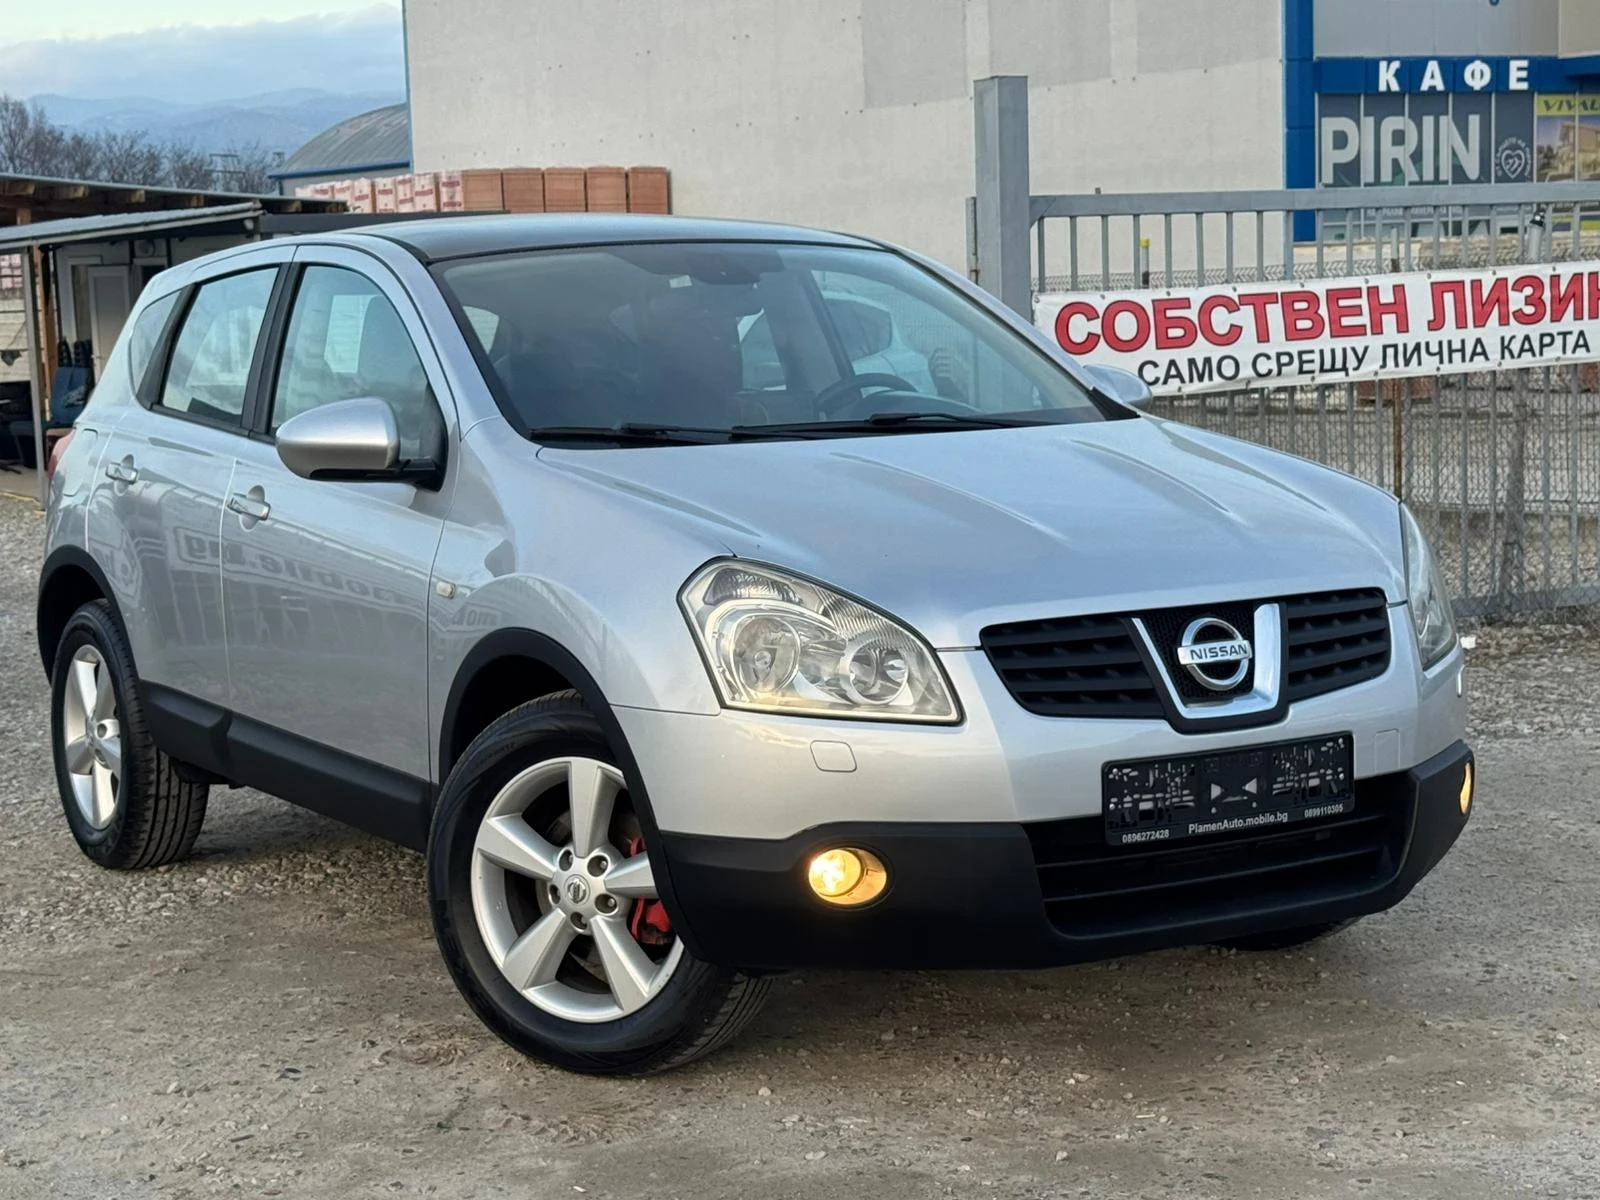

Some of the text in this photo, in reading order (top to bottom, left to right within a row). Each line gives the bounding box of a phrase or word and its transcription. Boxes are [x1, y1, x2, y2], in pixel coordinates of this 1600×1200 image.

[1378, 60, 1529, 92] КАФЕ
[1543, 98, 1600, 112] VIVAL
[1321, 114, 1480, 184] PIRIN
[1055, 283, 1410, 355] СОБСТВЕН
[1138, 329, 1591, 386] САМО СРЕЩУ ЛИЧНА КАРТА
[1190, 644, 1248, 660] NISSAN
[1188, 811, 1289, 834] PlamenAuto.mobile.bg
